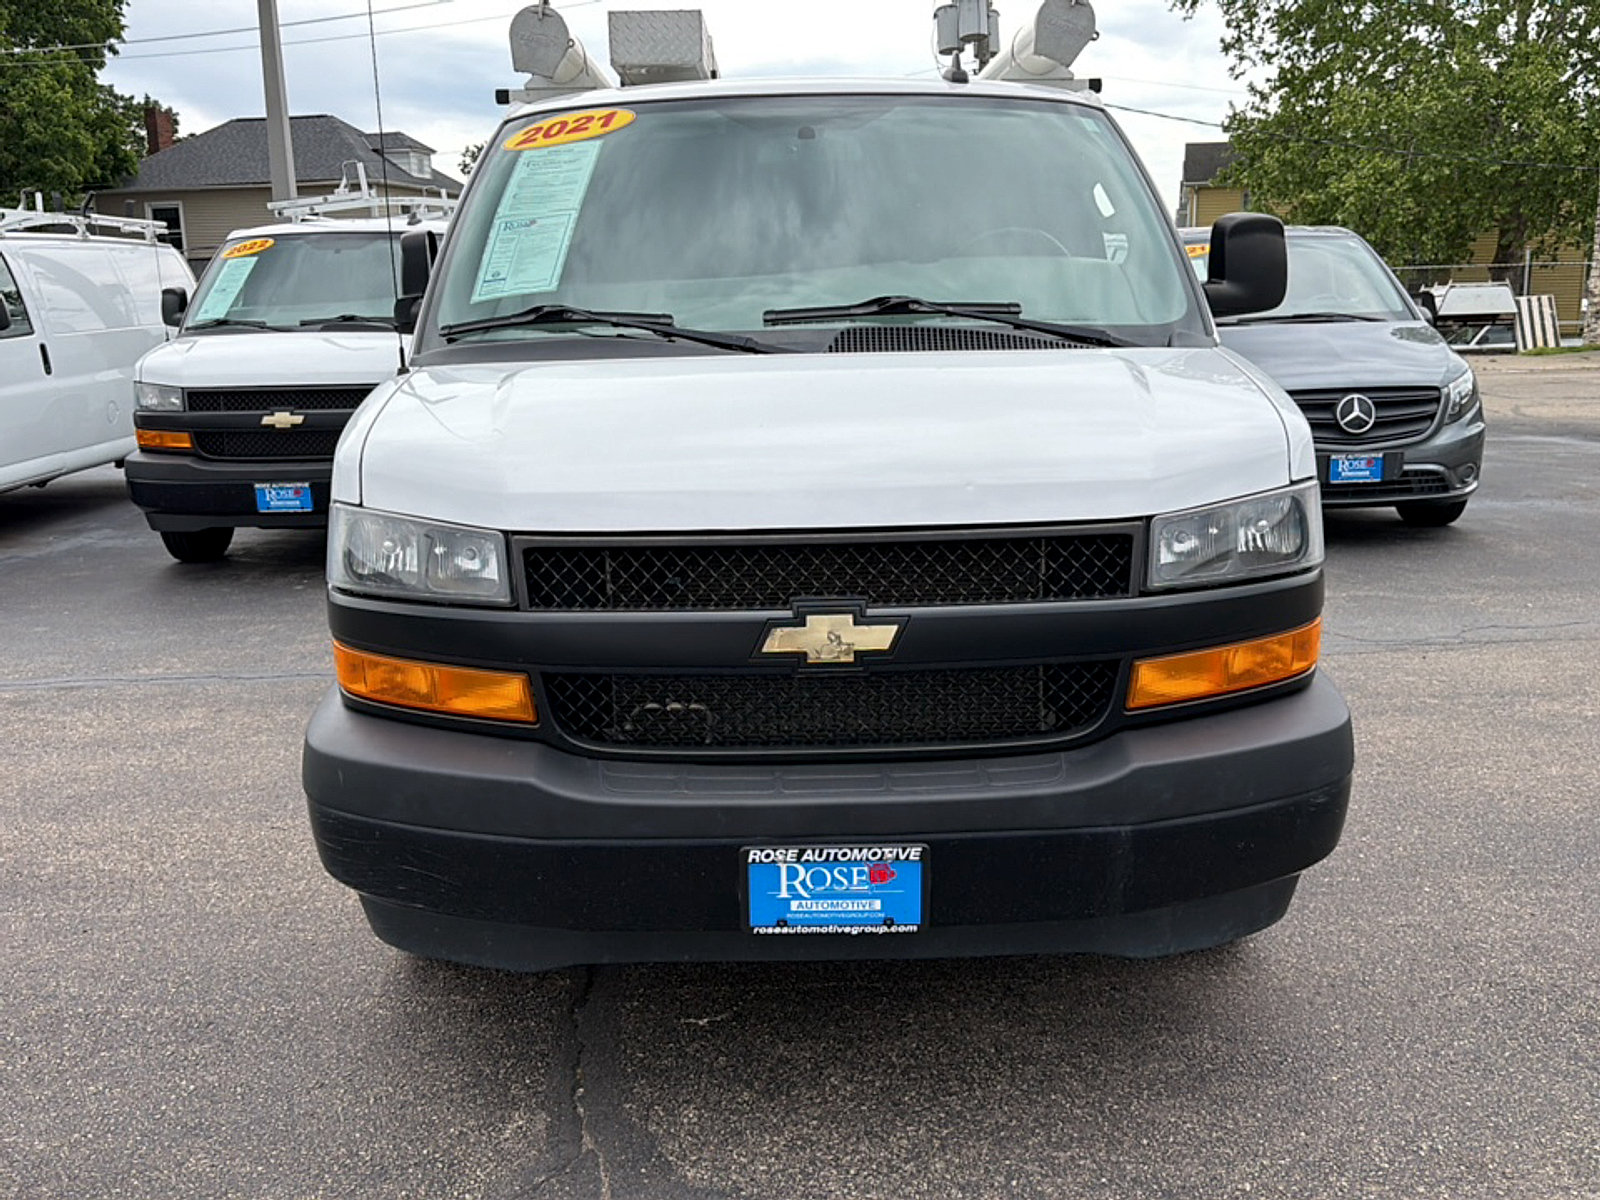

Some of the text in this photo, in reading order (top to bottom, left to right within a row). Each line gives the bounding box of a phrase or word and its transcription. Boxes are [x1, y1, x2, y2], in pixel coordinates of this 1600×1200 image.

[515, 111, 618, 147] 2021
[226, 240, 269, 256] 2022
[748, 847, 922, 863] ROSE AUTOMOTIVE
[776, 863, 869, 898] ROSE
[796, 901, 876, 910] AUTOMOTIVE
[753, 925, 918, 935] roseautomotivegroup.com
